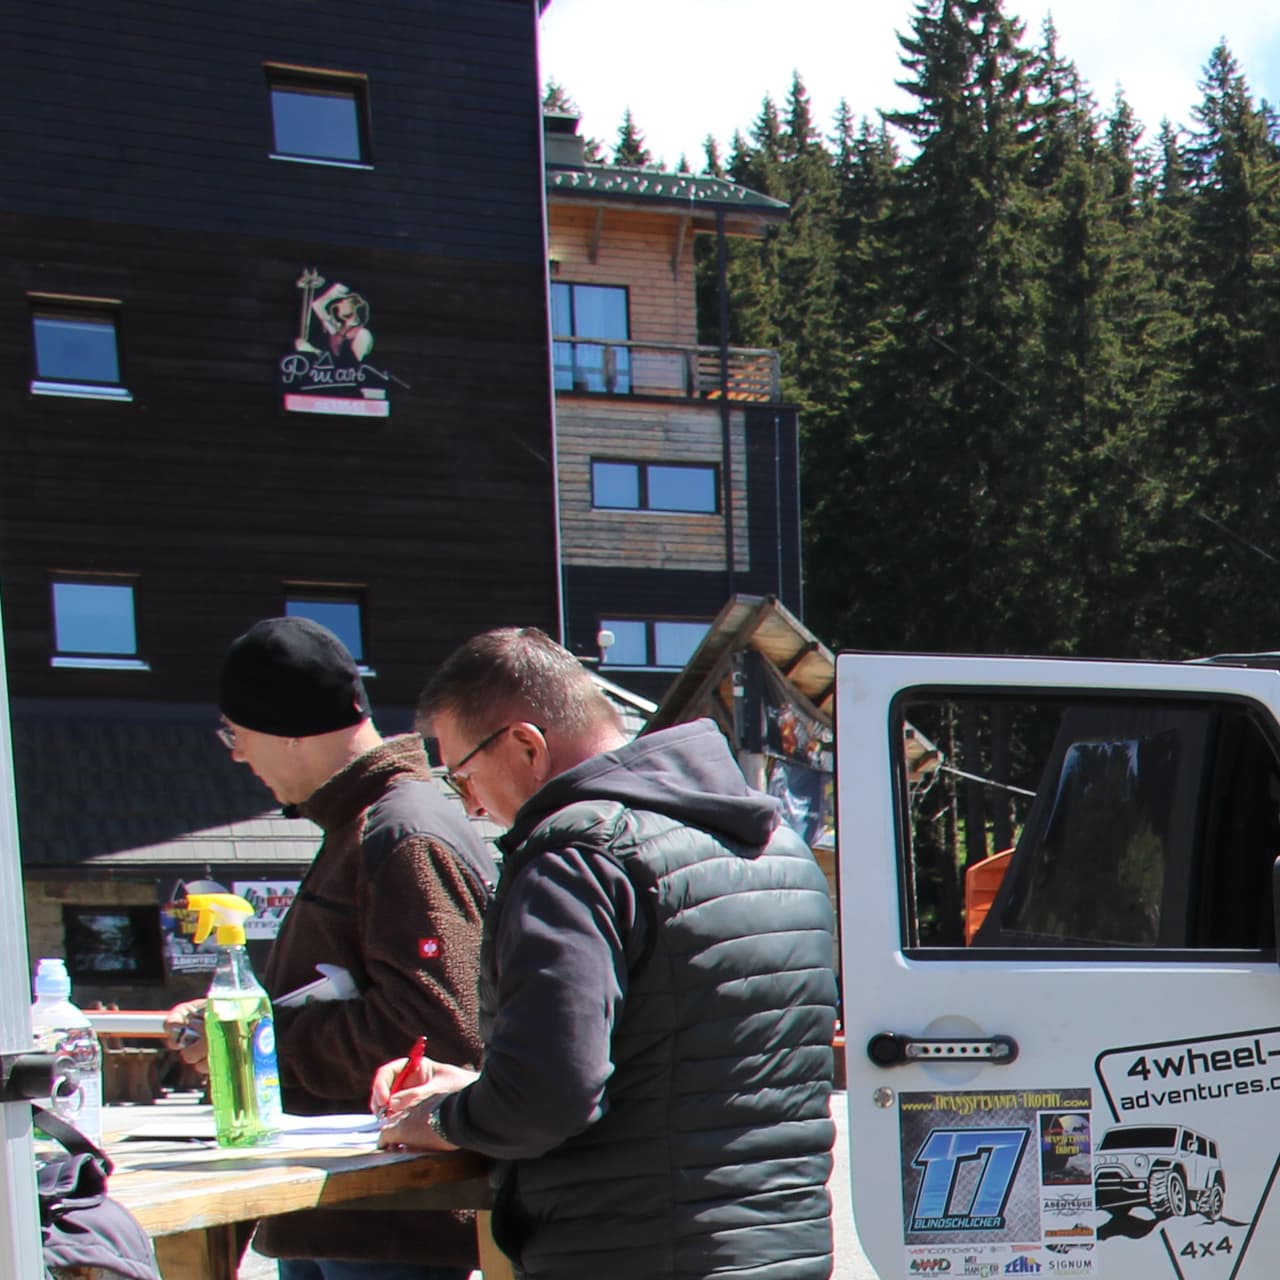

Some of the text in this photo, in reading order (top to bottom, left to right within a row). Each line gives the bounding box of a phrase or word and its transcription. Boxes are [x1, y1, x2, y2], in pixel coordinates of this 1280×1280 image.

[912, 1128, 1032, 1218] 17
[1180, 1236, 1233, 1259] 4x4
[1049, 1259, 1092, 1271] SIGNUM
